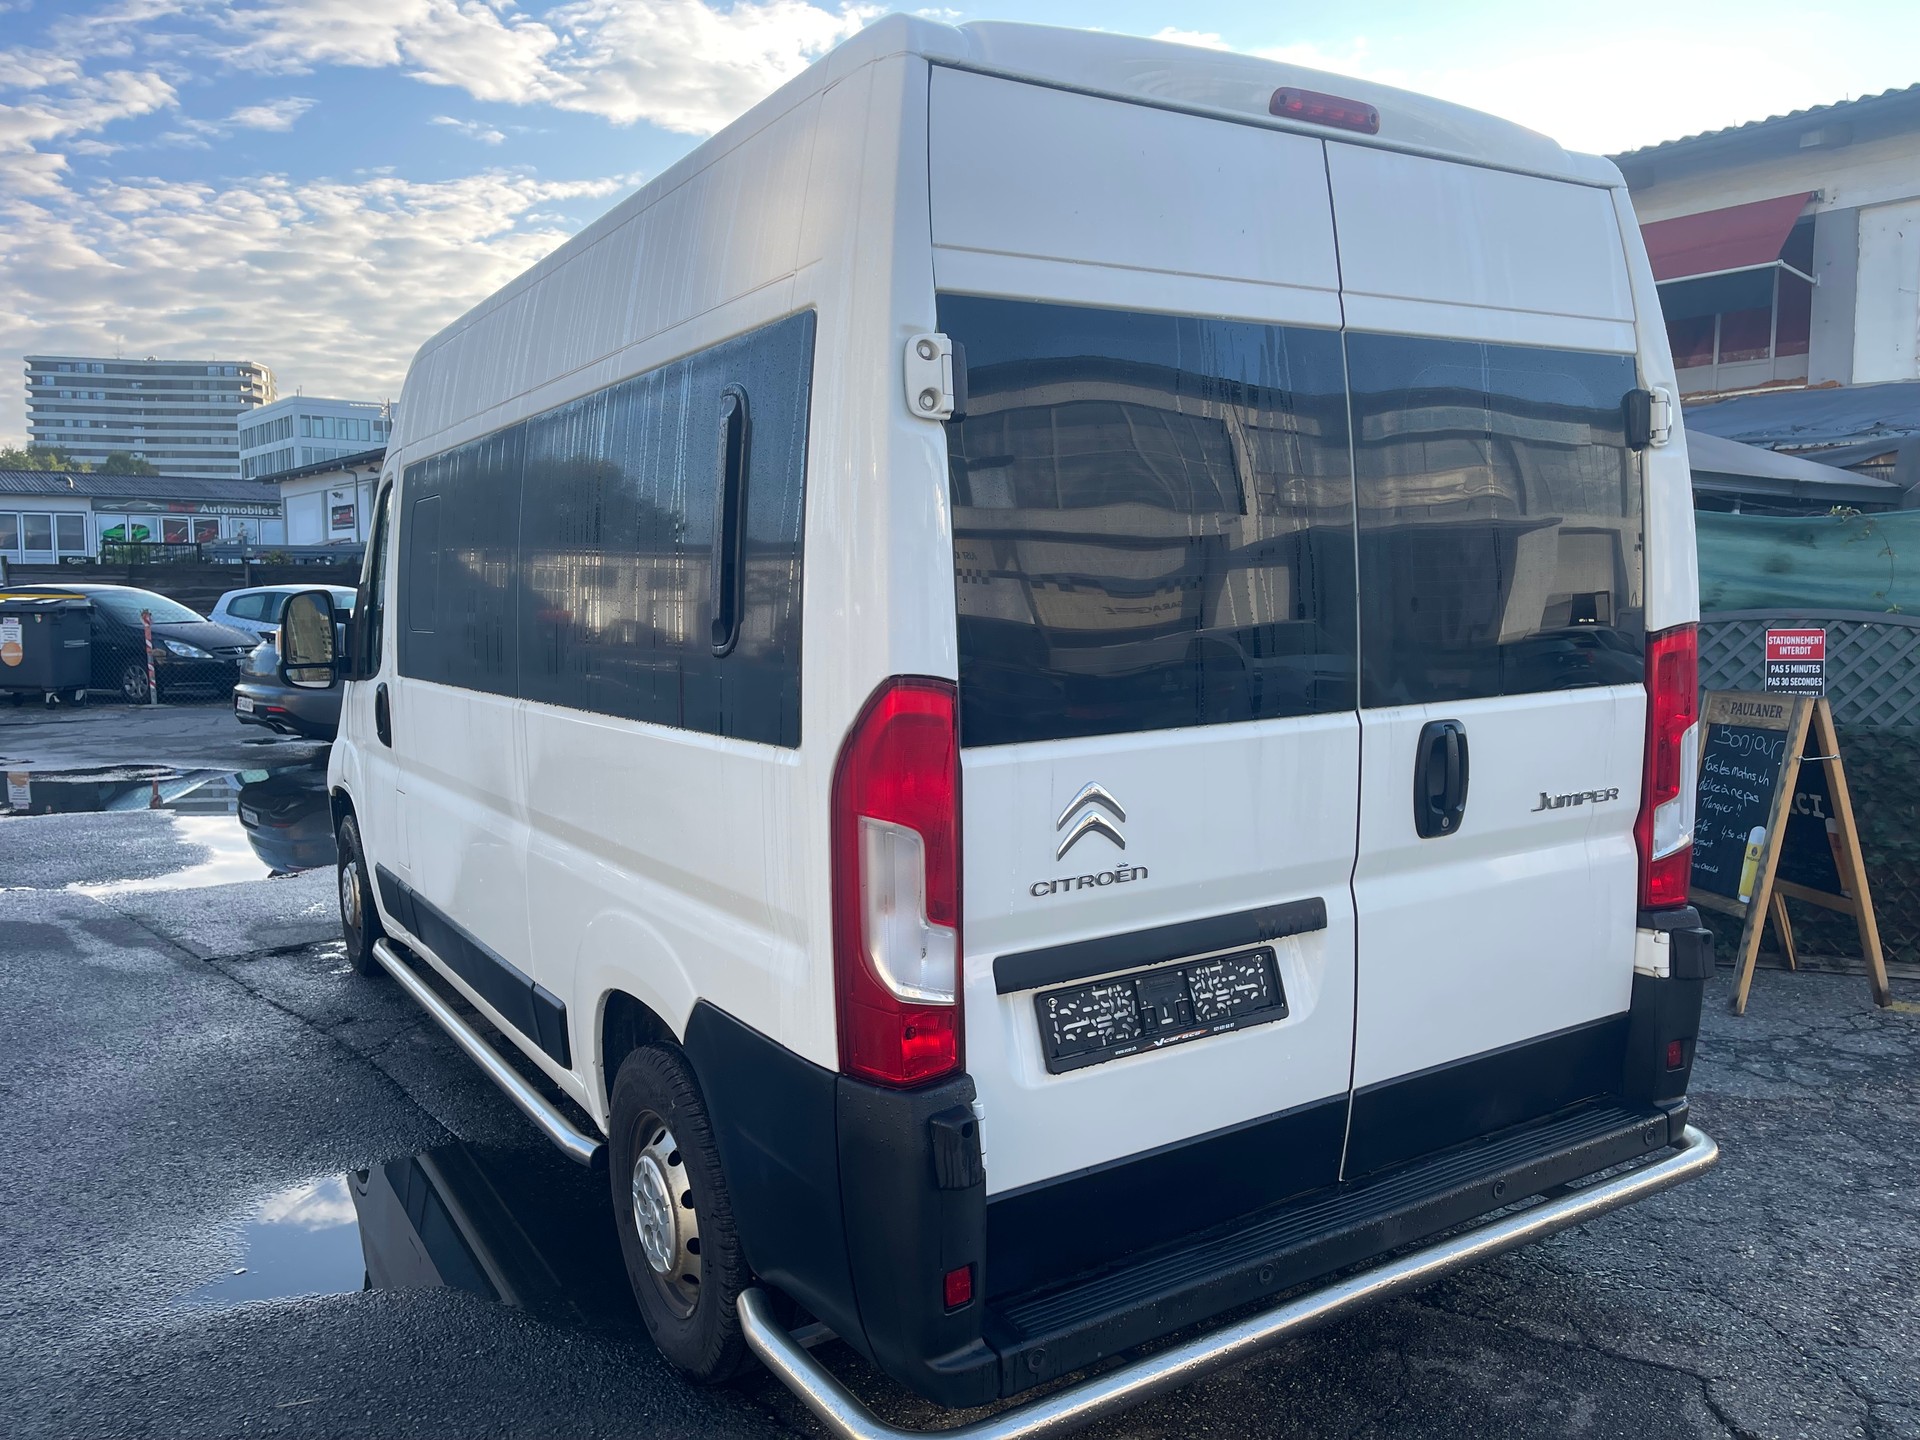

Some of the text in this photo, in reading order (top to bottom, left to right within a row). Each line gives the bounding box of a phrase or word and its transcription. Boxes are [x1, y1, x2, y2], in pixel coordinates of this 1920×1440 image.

[200, 504, 274, 515] Automobiles
[1768, 636, 1823, 645] STATIONNEMENT
[1779, 646, 1812, 655] INTERDIT
[1770, 664, 1821, 673] PAS 5 MINUTES
[1767, 677, 1823, 686] PAS 30 SECONDES
[1730, 702, 1784, 719] PAULANER
[1713, 725, 1786, 760] Bonjour
[1704, 753, 1719, 773] Tous
[1790, 792, 1825, 819] CI
